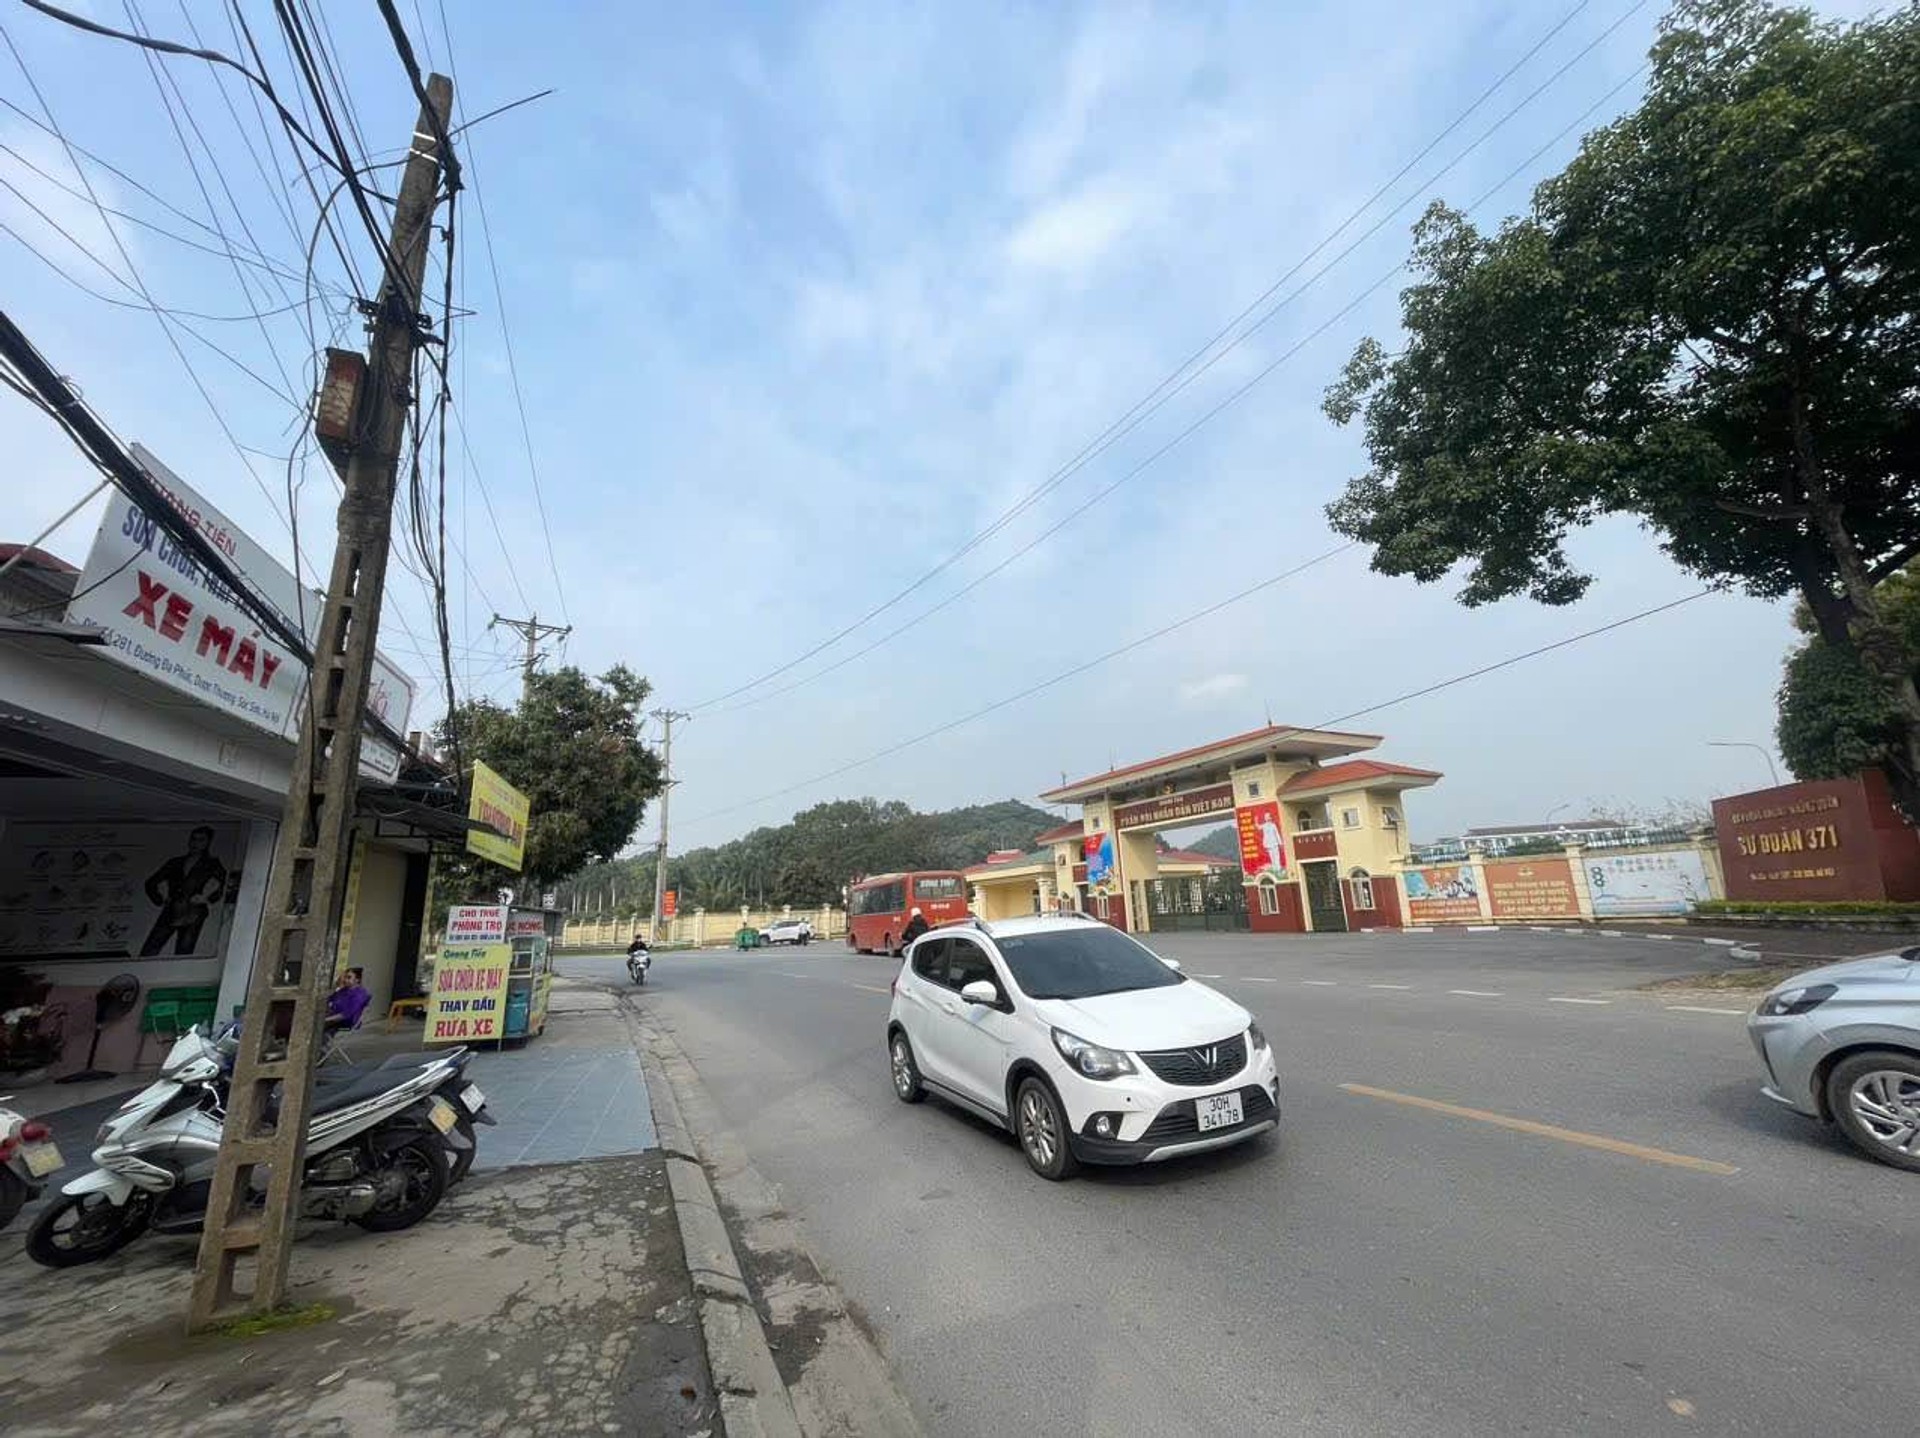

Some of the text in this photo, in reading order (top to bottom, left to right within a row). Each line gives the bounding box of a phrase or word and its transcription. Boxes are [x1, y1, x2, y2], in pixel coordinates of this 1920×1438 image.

[122, 570, 194, 643] XE
[195, 613, 282, 690] MÁY
[1805, 824, 1838, 849] 371
[459, 907, 500, 917] CHO THUÊ
[451, 919, 482, 931] PHÒNG
[438, 962, 504, 992] SỬA CHỮA XE MÁY
[440, 1000, 469, 1012] THAY
[434, 1016, 493, 1037] RỬA XE
[1210, 1096, 1230, 1111] 30H
